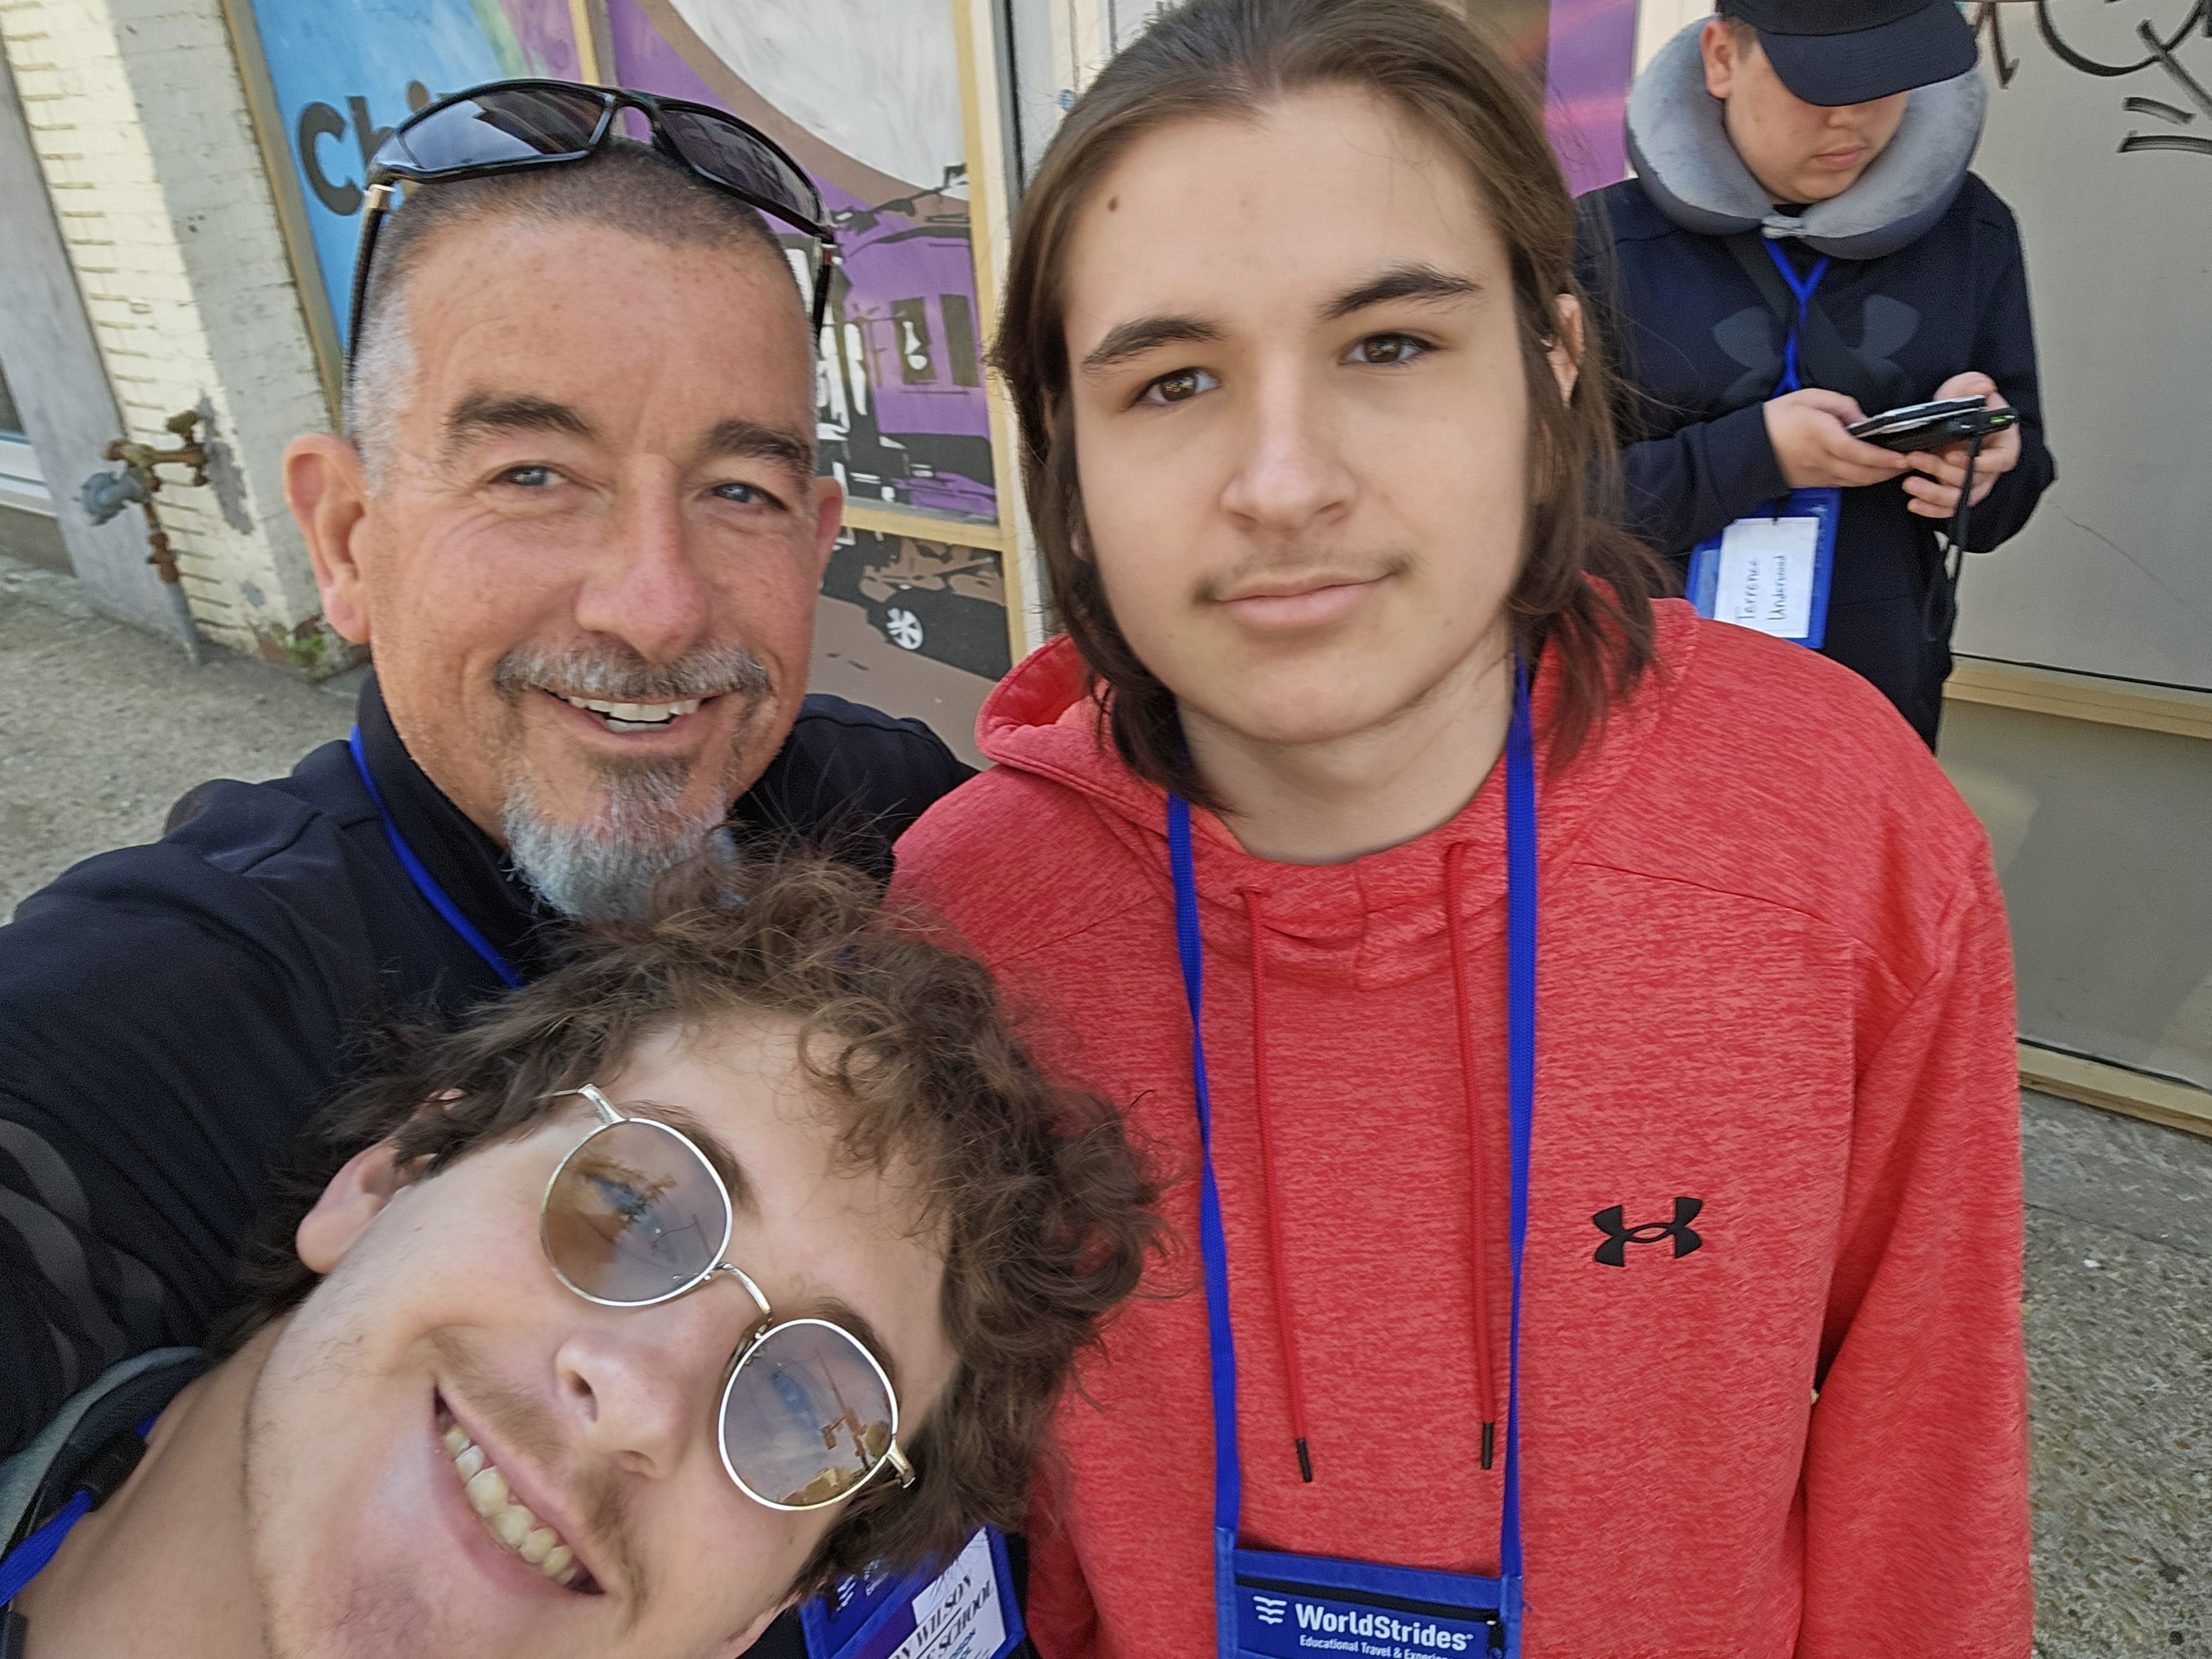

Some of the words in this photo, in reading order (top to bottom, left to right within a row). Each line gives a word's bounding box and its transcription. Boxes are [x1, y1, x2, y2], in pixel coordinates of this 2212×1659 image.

[916, 1571, 972, 1648] WILSON
[938, 1579, 994, 1658] SCHOOL
[1299, 1634, 1359, 1652] Educational
[1360, 1642, 1392, 1658] Travel
[1392, 1646, 1403, 1659] &
